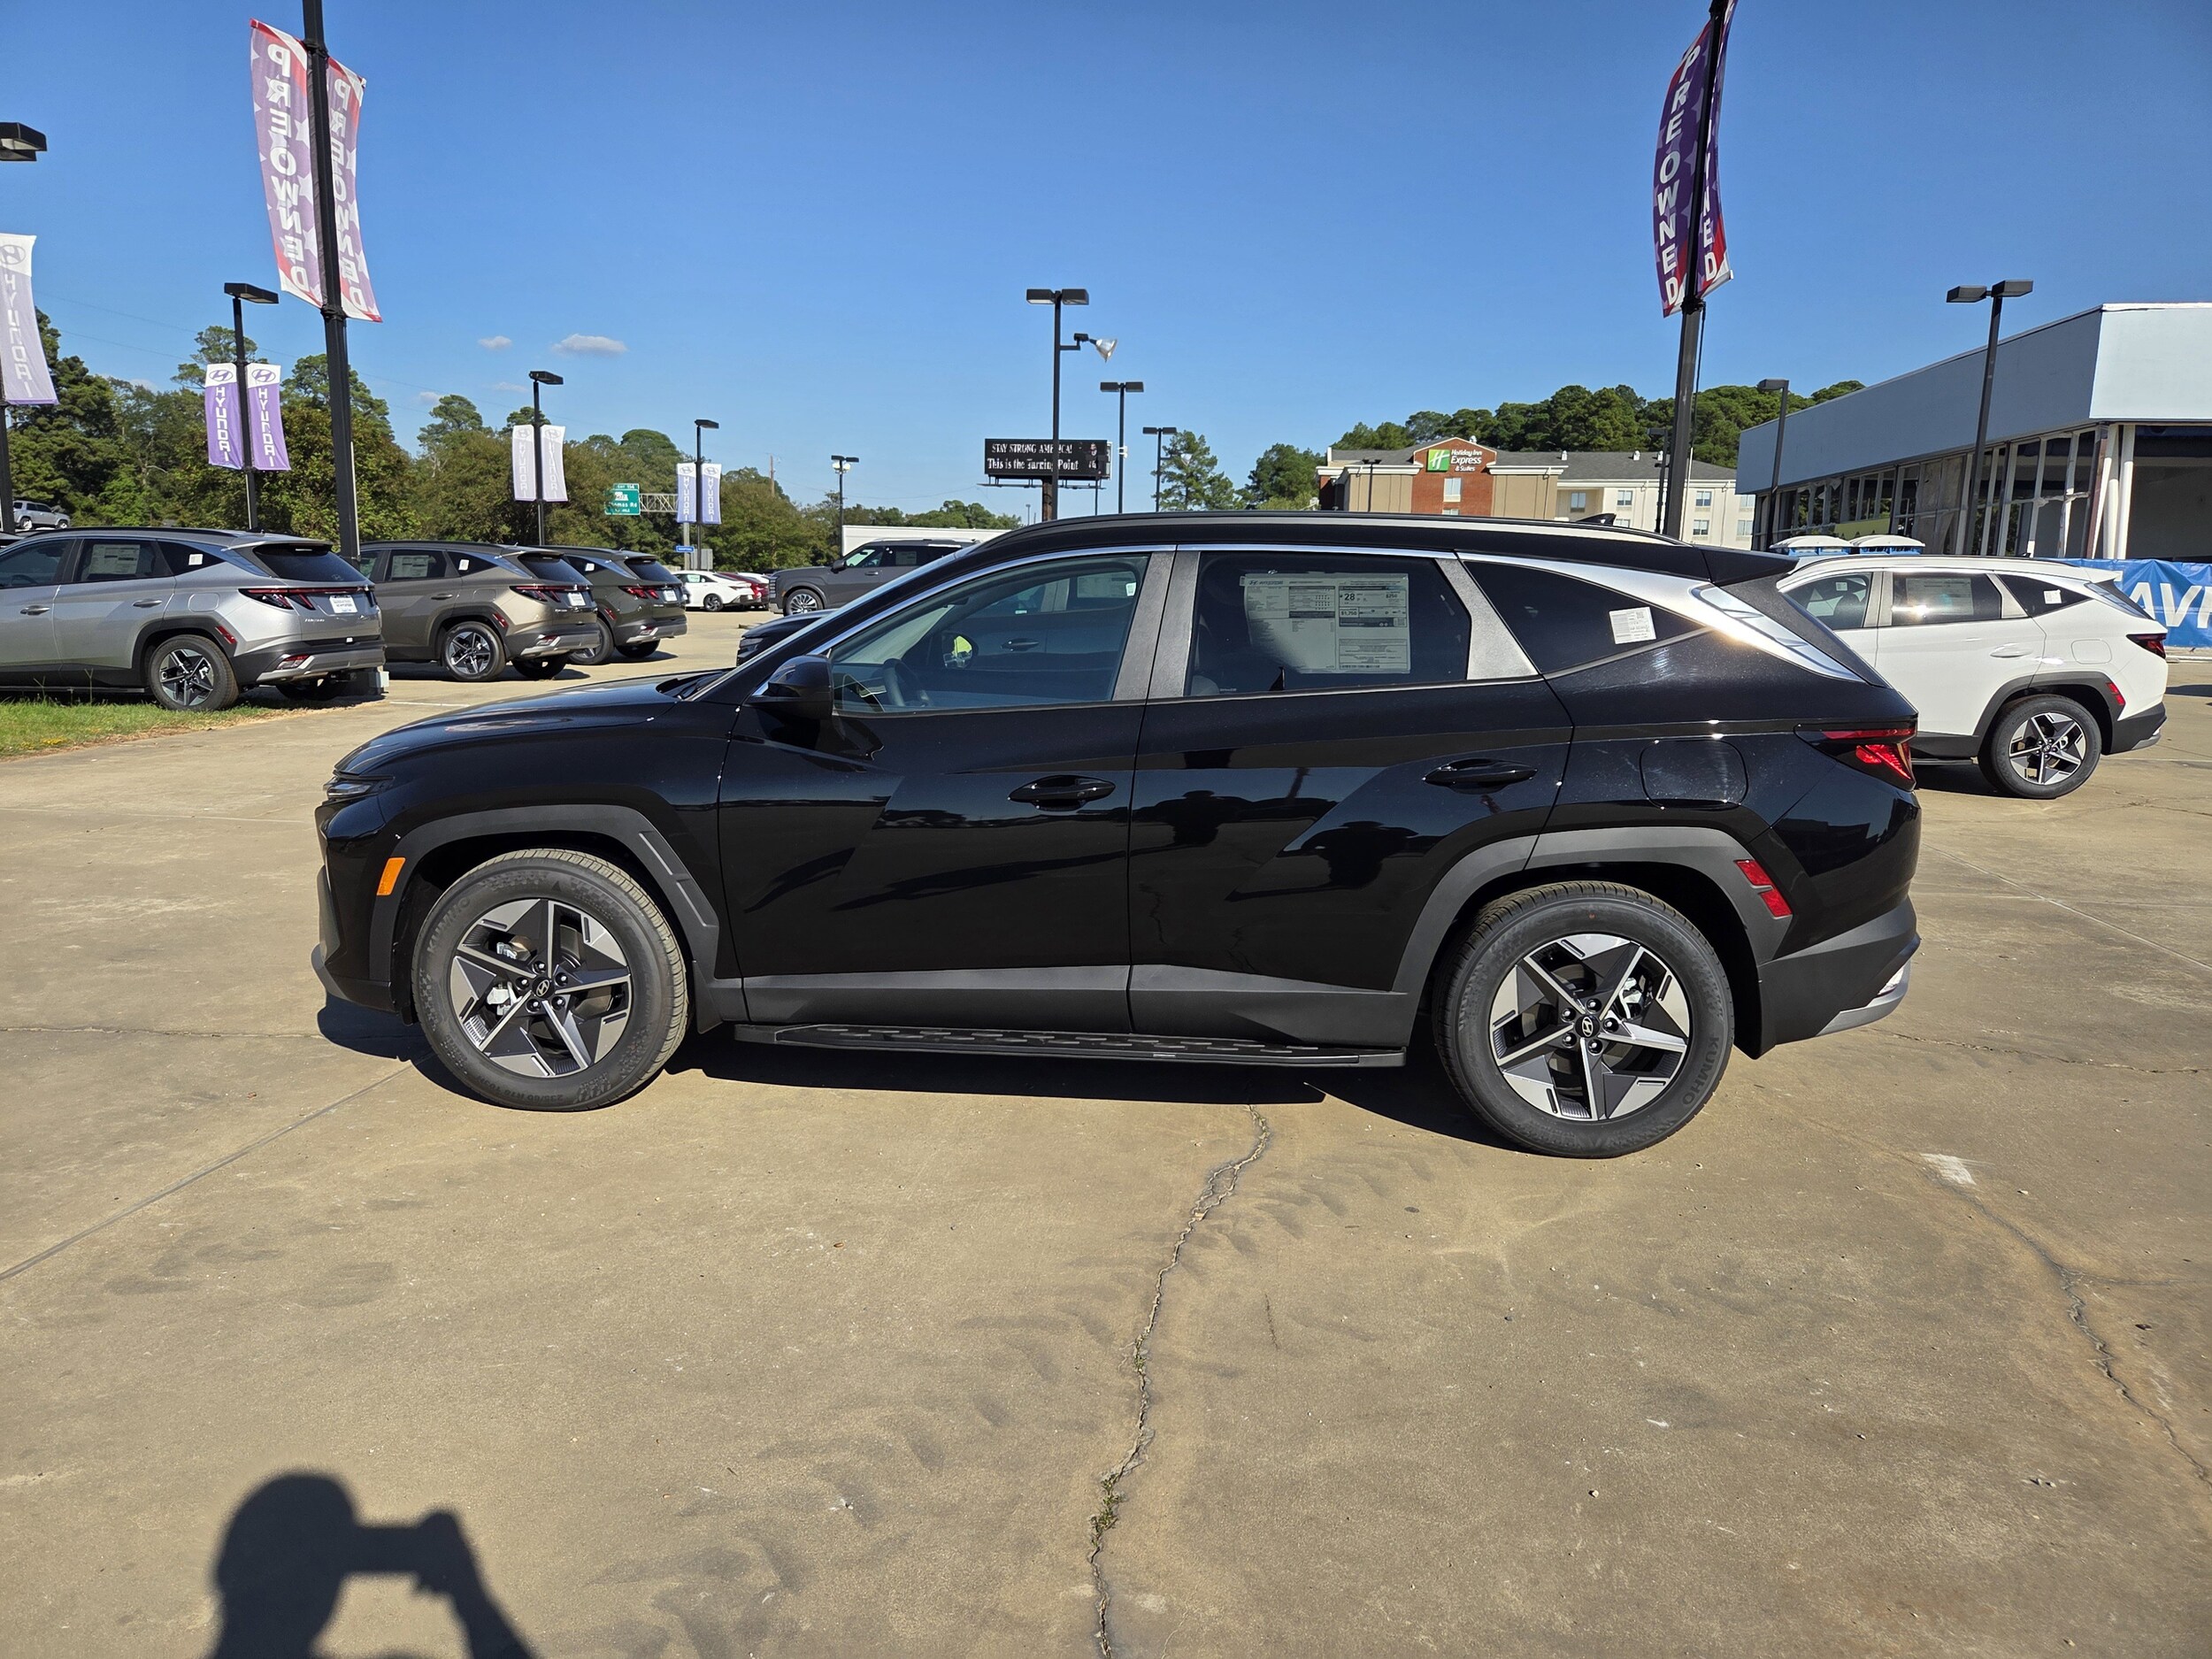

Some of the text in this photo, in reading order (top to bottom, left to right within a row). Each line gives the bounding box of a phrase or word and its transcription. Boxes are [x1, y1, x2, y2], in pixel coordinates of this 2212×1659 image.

[1657, 45, 1701, 305] PREOWNED
[215, 387, 231, 462] HYUNDAI
[258, 388, 276, 467] HYUNDAI
[987, 457, 1079, 472] This is the Turnin Point
[992, 443, 1072, 455] STAY STRONG AMEICA!
[1450, 456, 1482, 465] Express
[1451, 449, 1472, 457] Holiday
[1683, 1034, 1720, 1105] KUMHO
